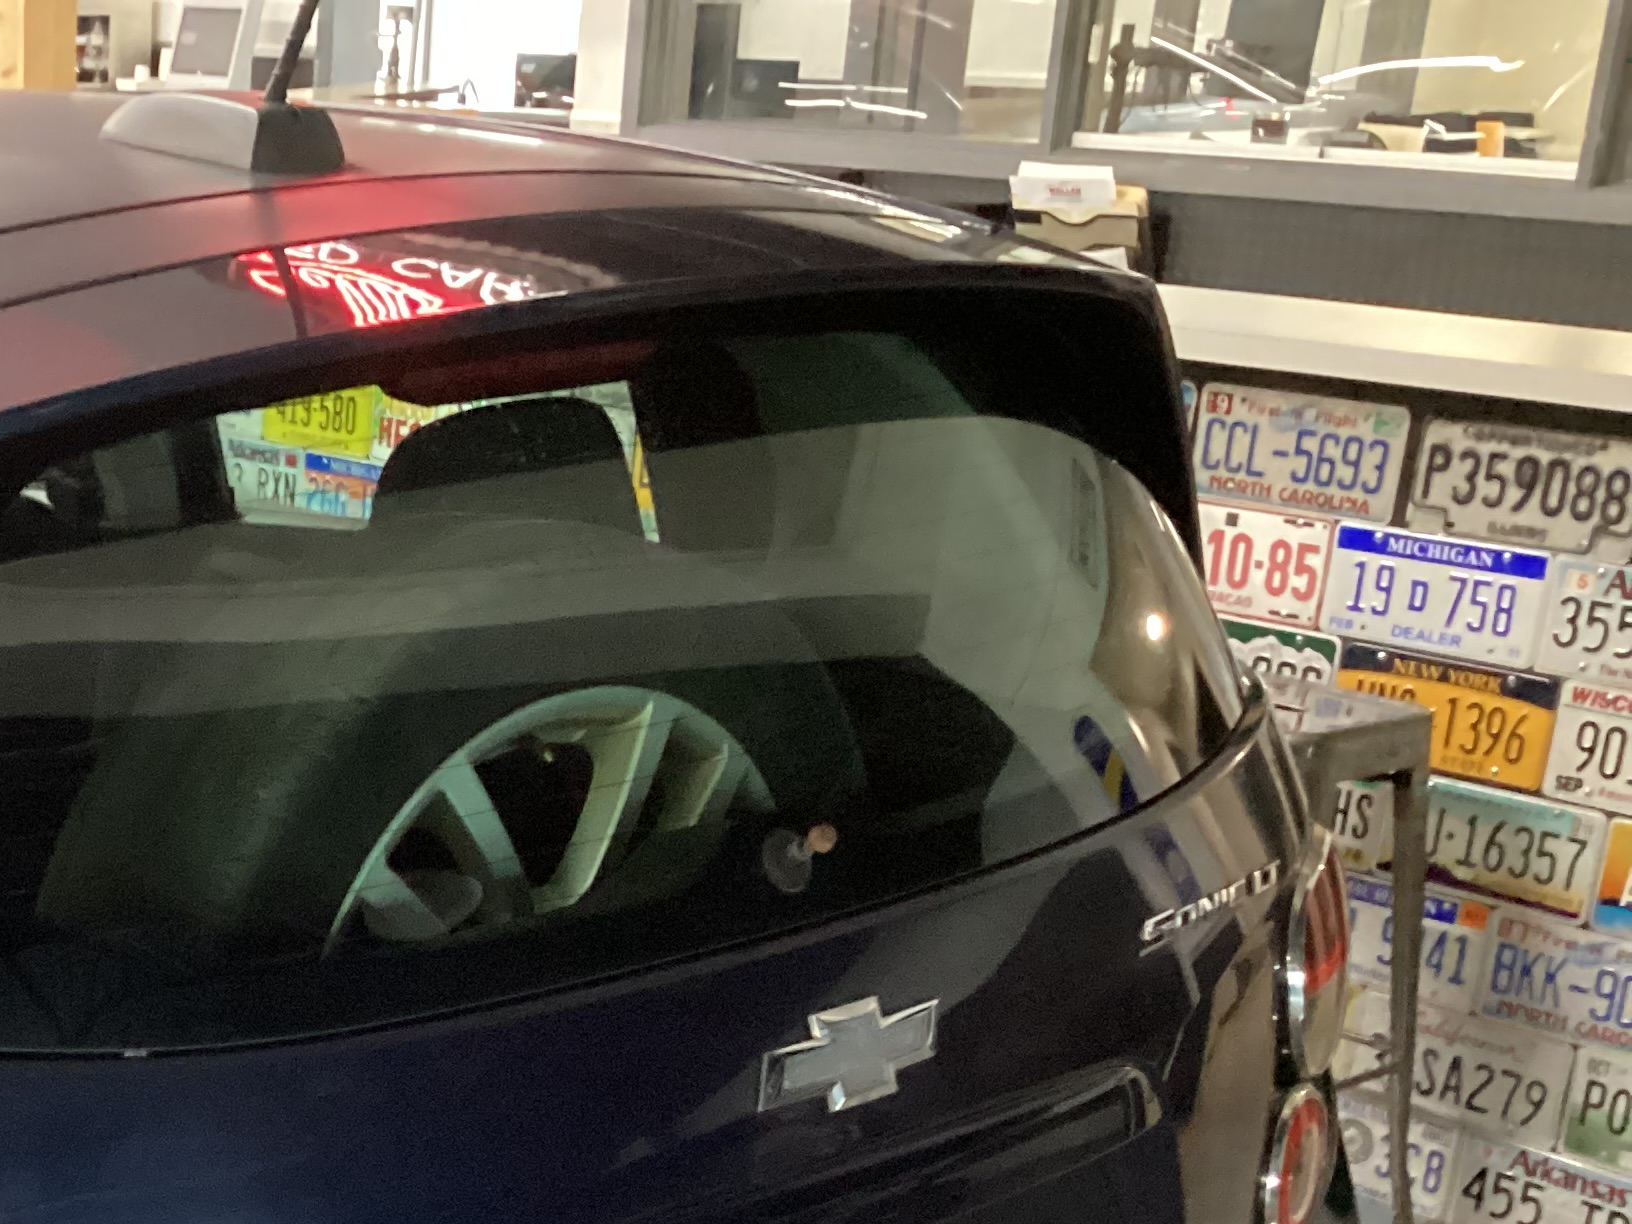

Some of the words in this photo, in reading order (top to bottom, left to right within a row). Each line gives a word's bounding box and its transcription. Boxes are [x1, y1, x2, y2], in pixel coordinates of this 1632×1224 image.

[1201, 417, 1391, 495] CCL-5693
[1209, 474, 1272, 498] NORTH
[1278, 486, 1371, 516] CAROLINA
[1421, 442, 1632, 526] P359088
[1386, 536, 1496, 568] MICHIGAN
[1346, 557, 1397, 617] 19
[1444, 571, 1518, 637] 758
[1391, 624, 1462, 648] DEALER
[1392, 657, 1444, 681] NEW
[1447, 668, 1504, 695] YORK
